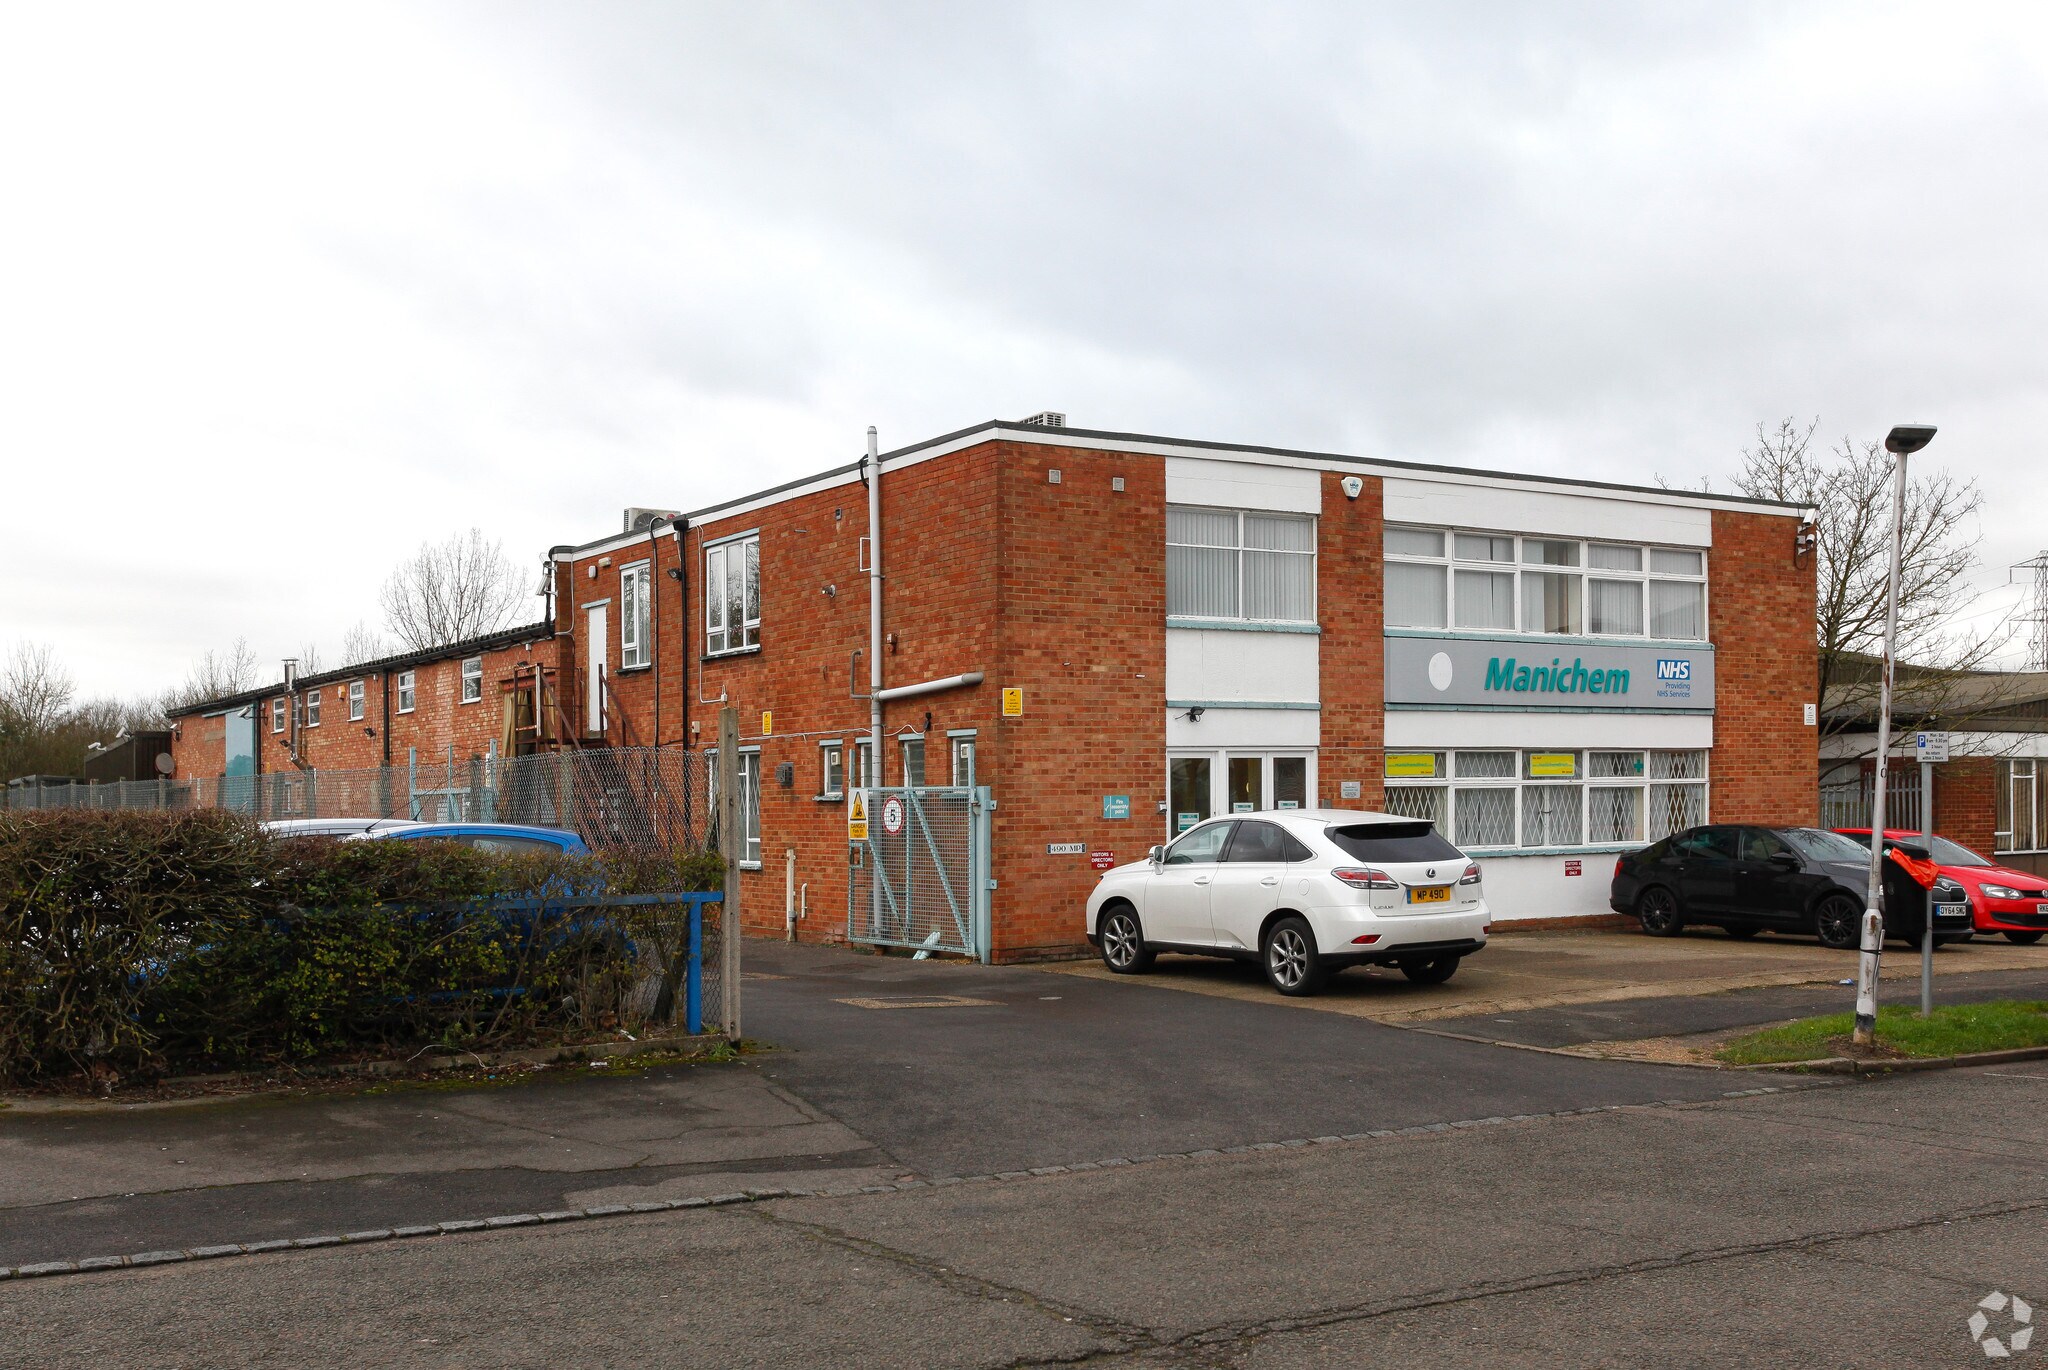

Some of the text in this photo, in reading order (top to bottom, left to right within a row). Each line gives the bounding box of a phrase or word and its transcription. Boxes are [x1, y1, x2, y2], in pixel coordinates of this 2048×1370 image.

[1484, 657, 1630, 693] Manichem
[1658, 661, 1689, 678] NHS
[1665, 682, 1690, 691] Providing
[1669, 690, 1690, 698] Services
[890, 809, 896, 823] 5
[1417, 889, 1444, 900] MP 490
[1941, 906, 1955, 914] OY64
